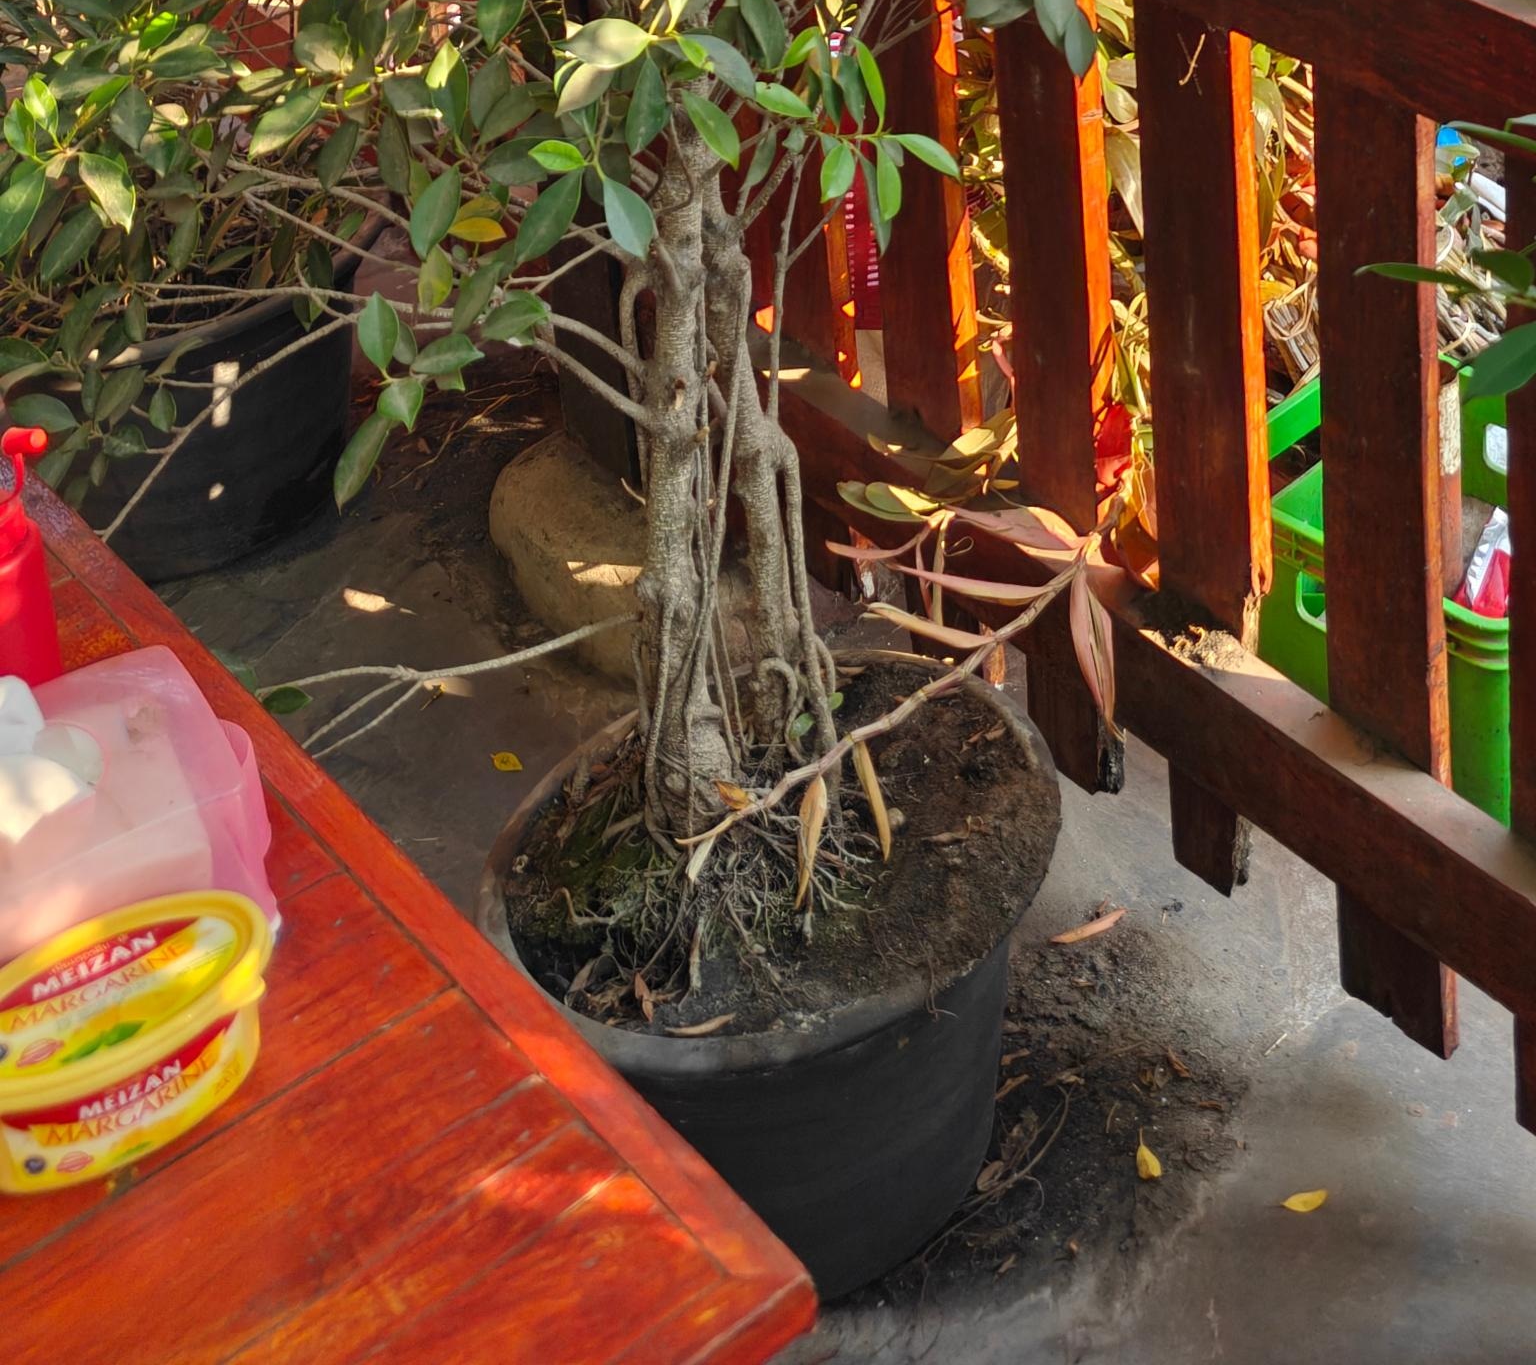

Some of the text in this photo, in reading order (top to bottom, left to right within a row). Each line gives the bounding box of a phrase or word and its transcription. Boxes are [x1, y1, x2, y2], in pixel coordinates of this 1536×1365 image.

[31, 930, 157, 1001] MEIZAN
[46, 1052, 211, 1145] MARGARINE
[78, 1059, 182, 1119] MEIZAN
